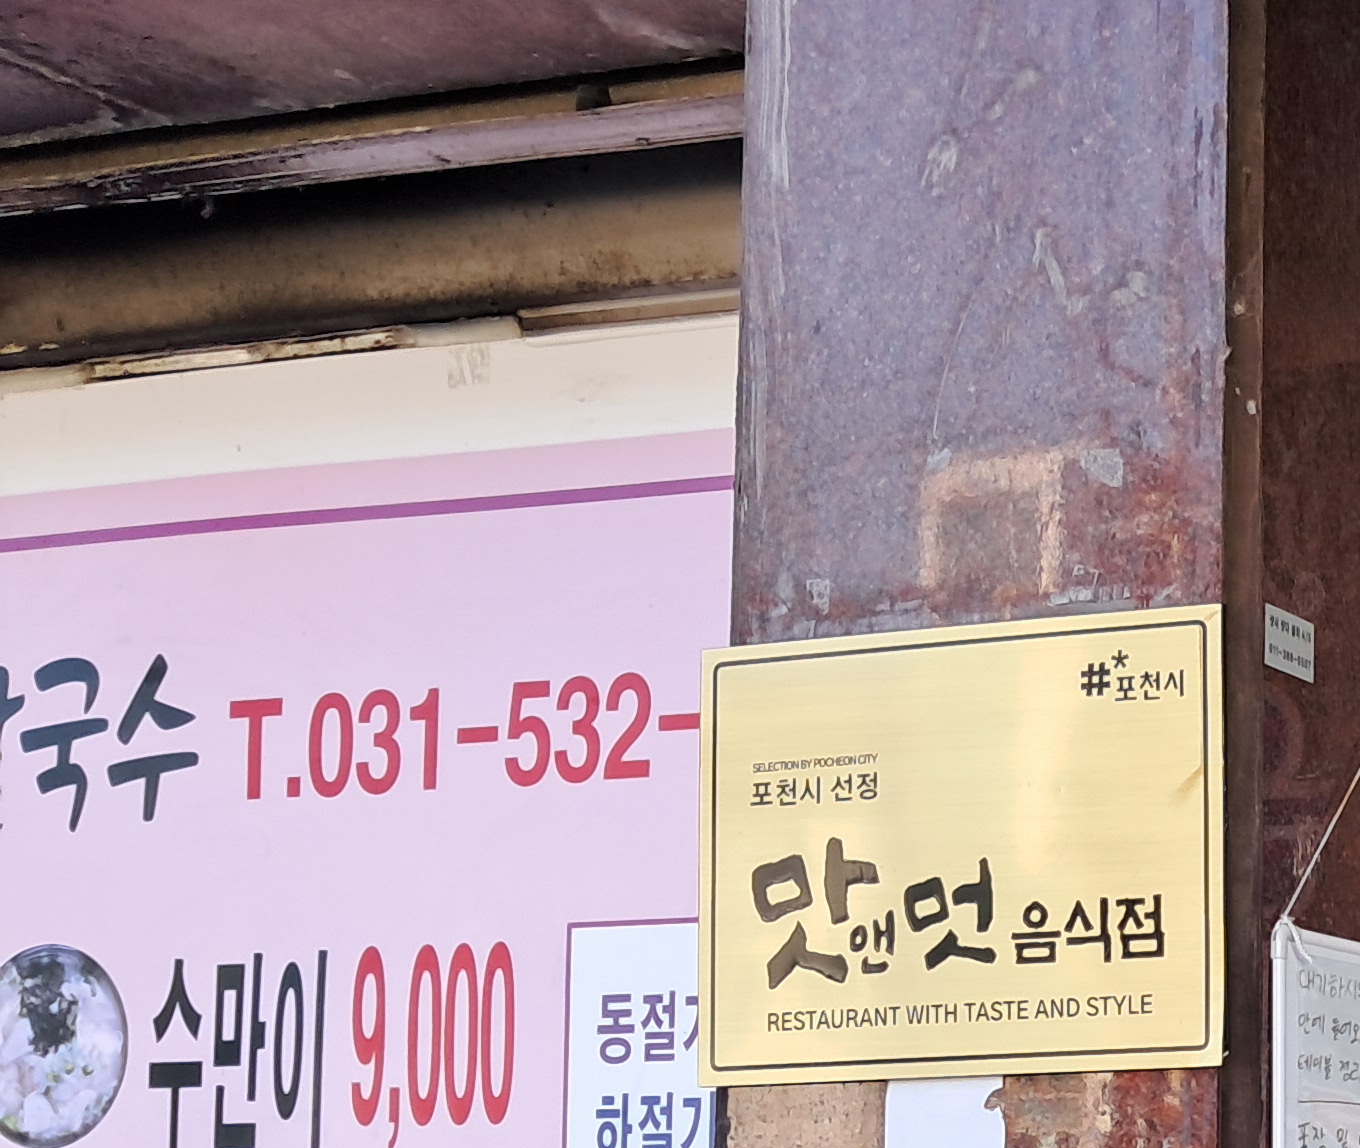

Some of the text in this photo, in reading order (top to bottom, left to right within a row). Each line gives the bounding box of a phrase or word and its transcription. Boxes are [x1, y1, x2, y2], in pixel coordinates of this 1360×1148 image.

[0, 654, 199, 832] 국수
[752, 753, 878, 773] SELECTION BY POCHEON CITY
[750, 771, 878, 806] 포천시 선정
[1011, 894, 1165, 965] 음식점
[767, 994, 1153, 1032] RESTAURANT WITH TASTE AND STYLE
[1298, 1013, 1326, 1035] 안에
[1297, 1053, 1333, 1081] 테이블
